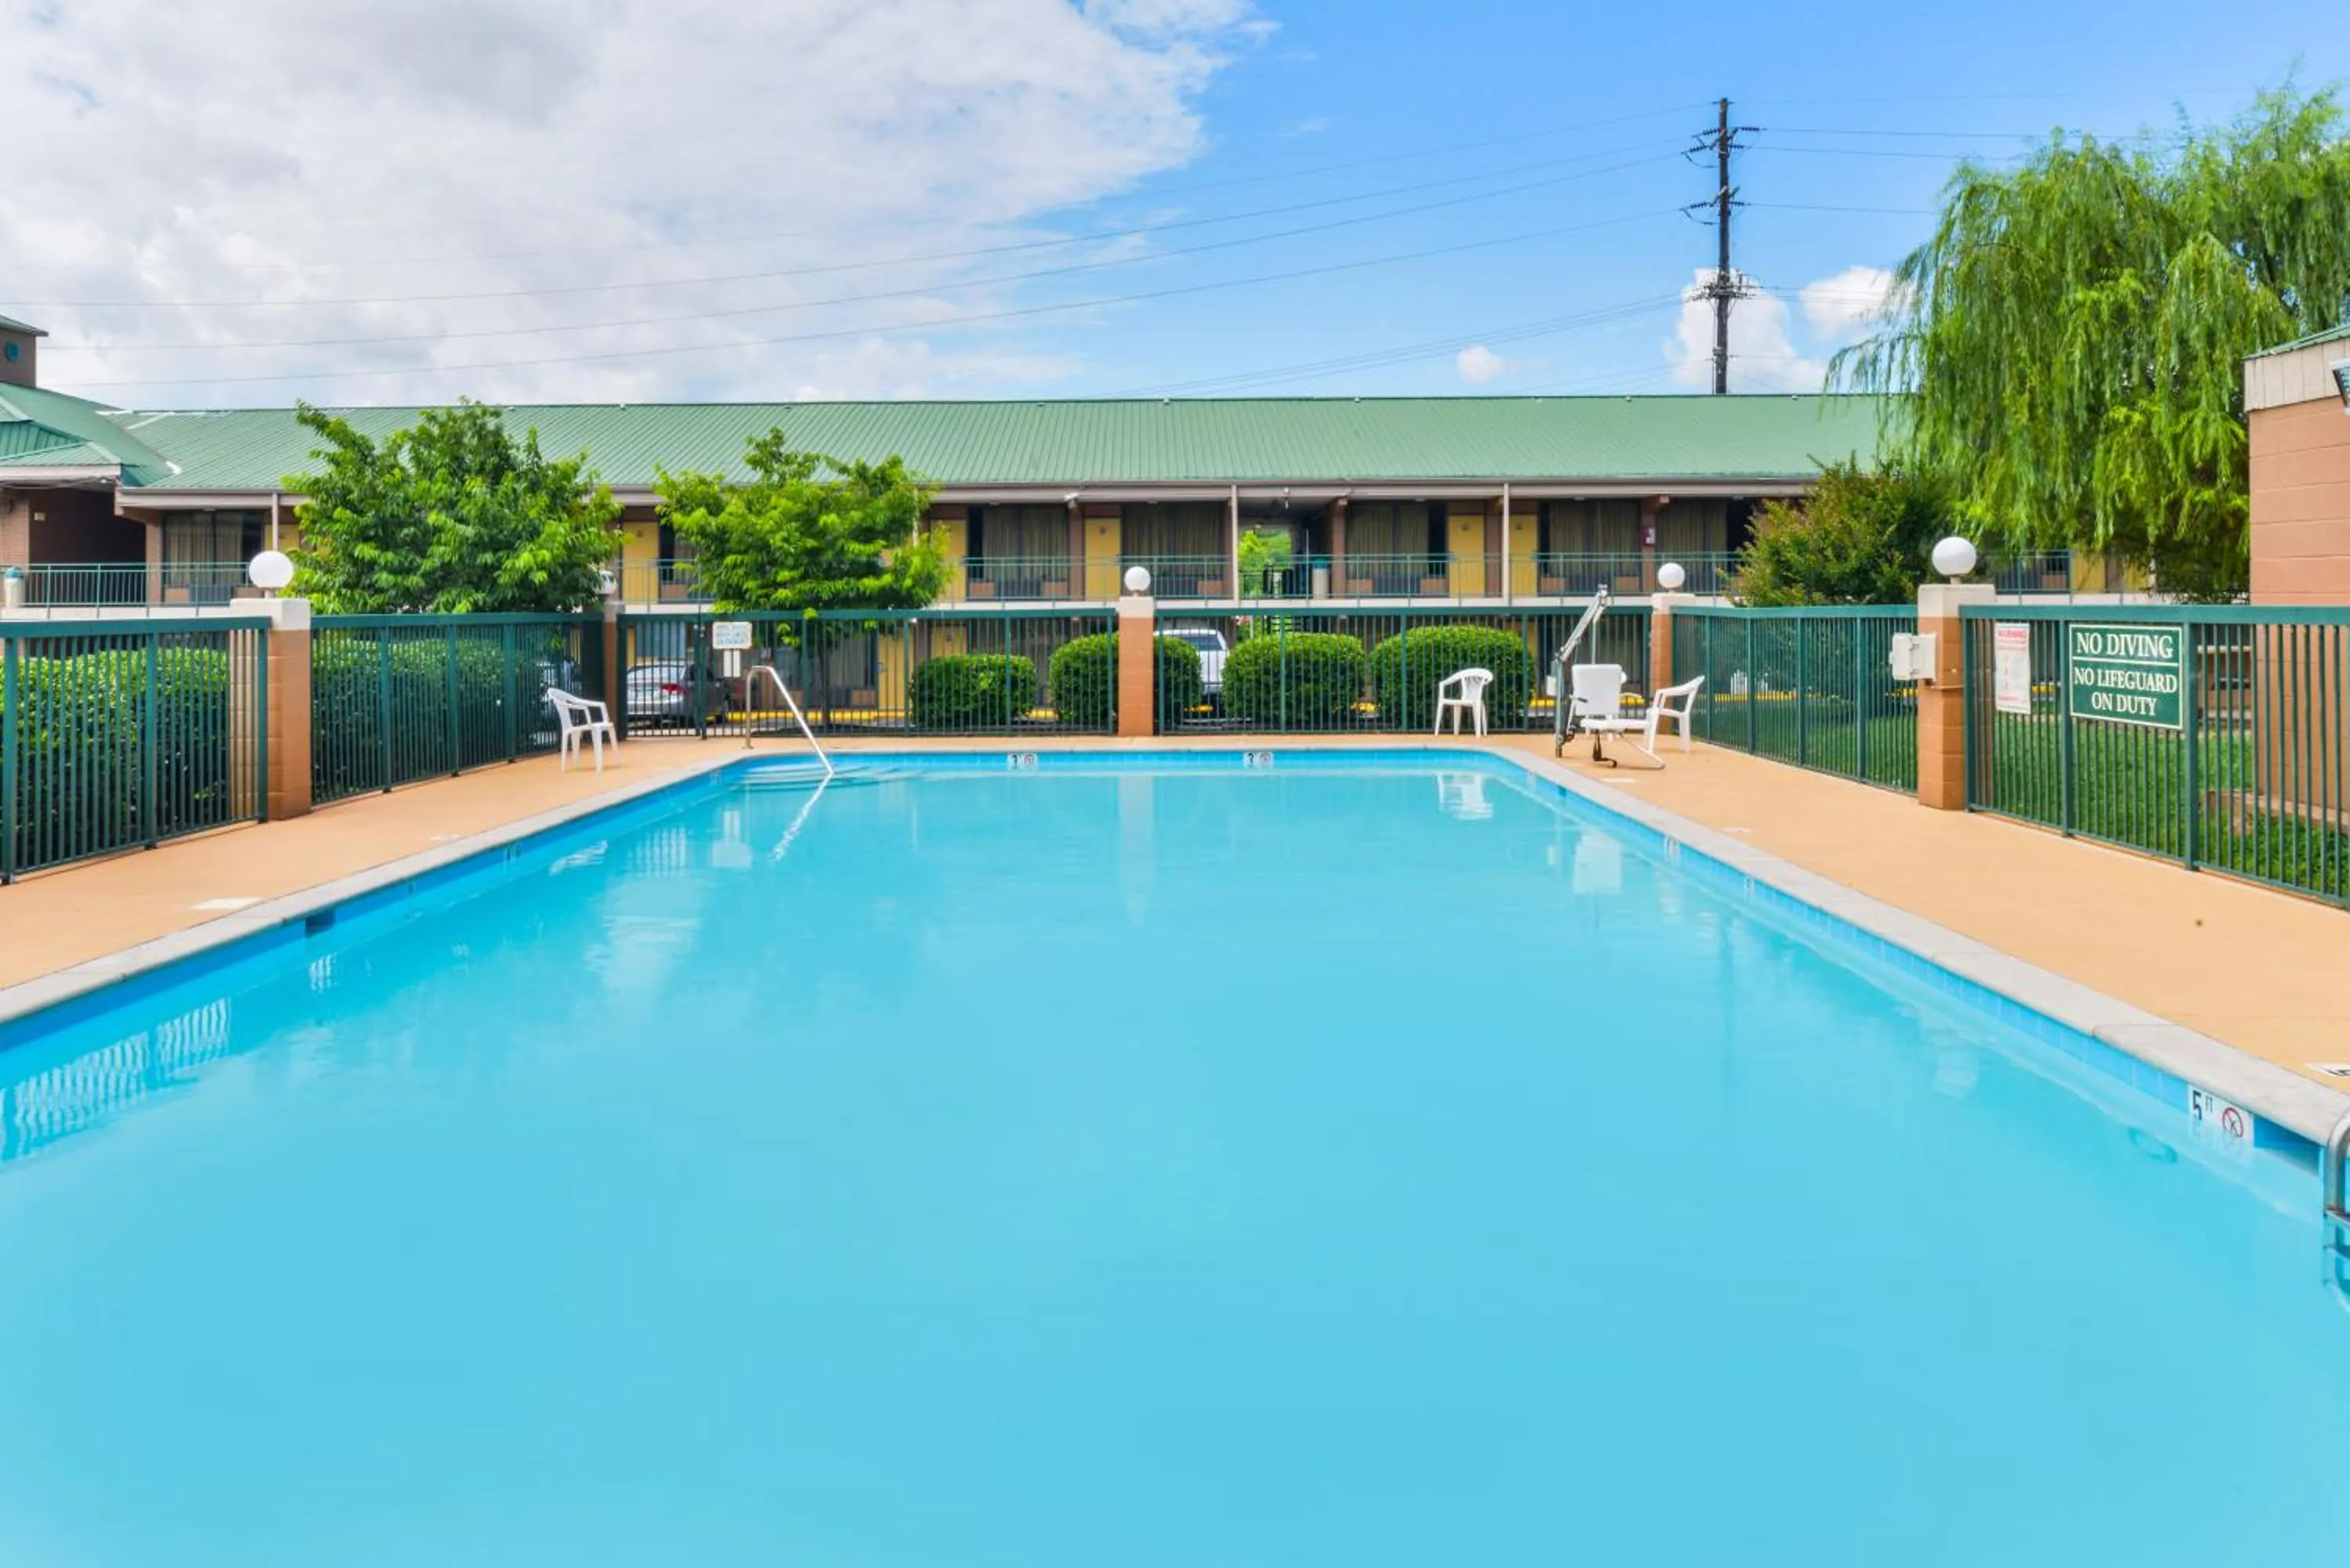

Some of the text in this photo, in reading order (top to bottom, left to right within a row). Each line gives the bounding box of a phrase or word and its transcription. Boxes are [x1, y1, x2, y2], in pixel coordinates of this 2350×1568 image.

[2077, 632, 2173, 659] NO DIVING
[2073, 667, 2178, 693] NO LIFEGUARD
[2092, 692, 2157, 716] ON DUTY
[2193, 1089, 2202, 1121] 5
